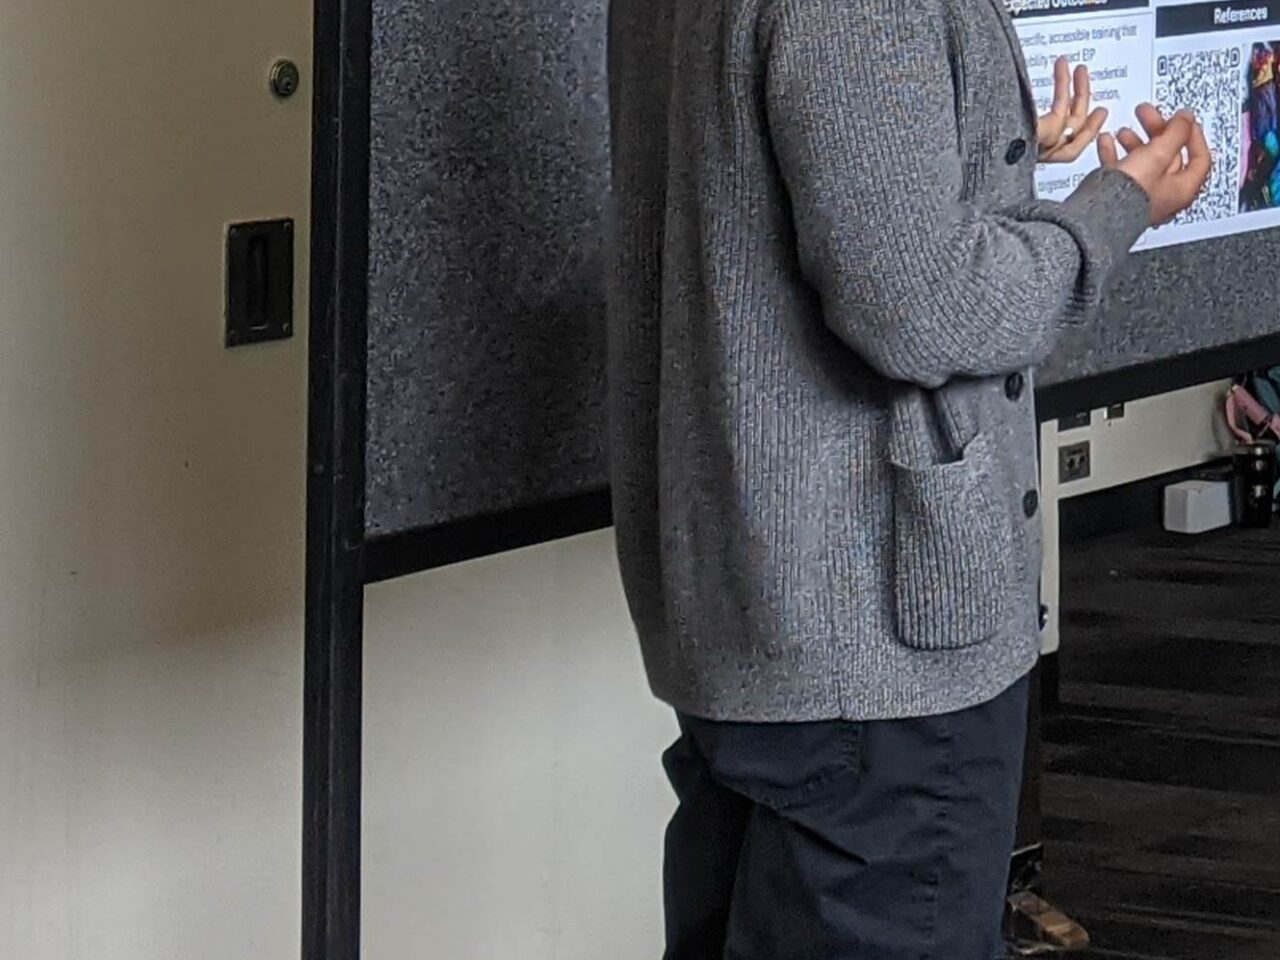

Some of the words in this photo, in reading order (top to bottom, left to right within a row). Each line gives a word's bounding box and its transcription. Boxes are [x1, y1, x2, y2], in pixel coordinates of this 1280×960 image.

[1214, 6, 1268, 25] References
[1048, 28, 1091, 44] accessible
[1092, 25, 1122, 41] training
